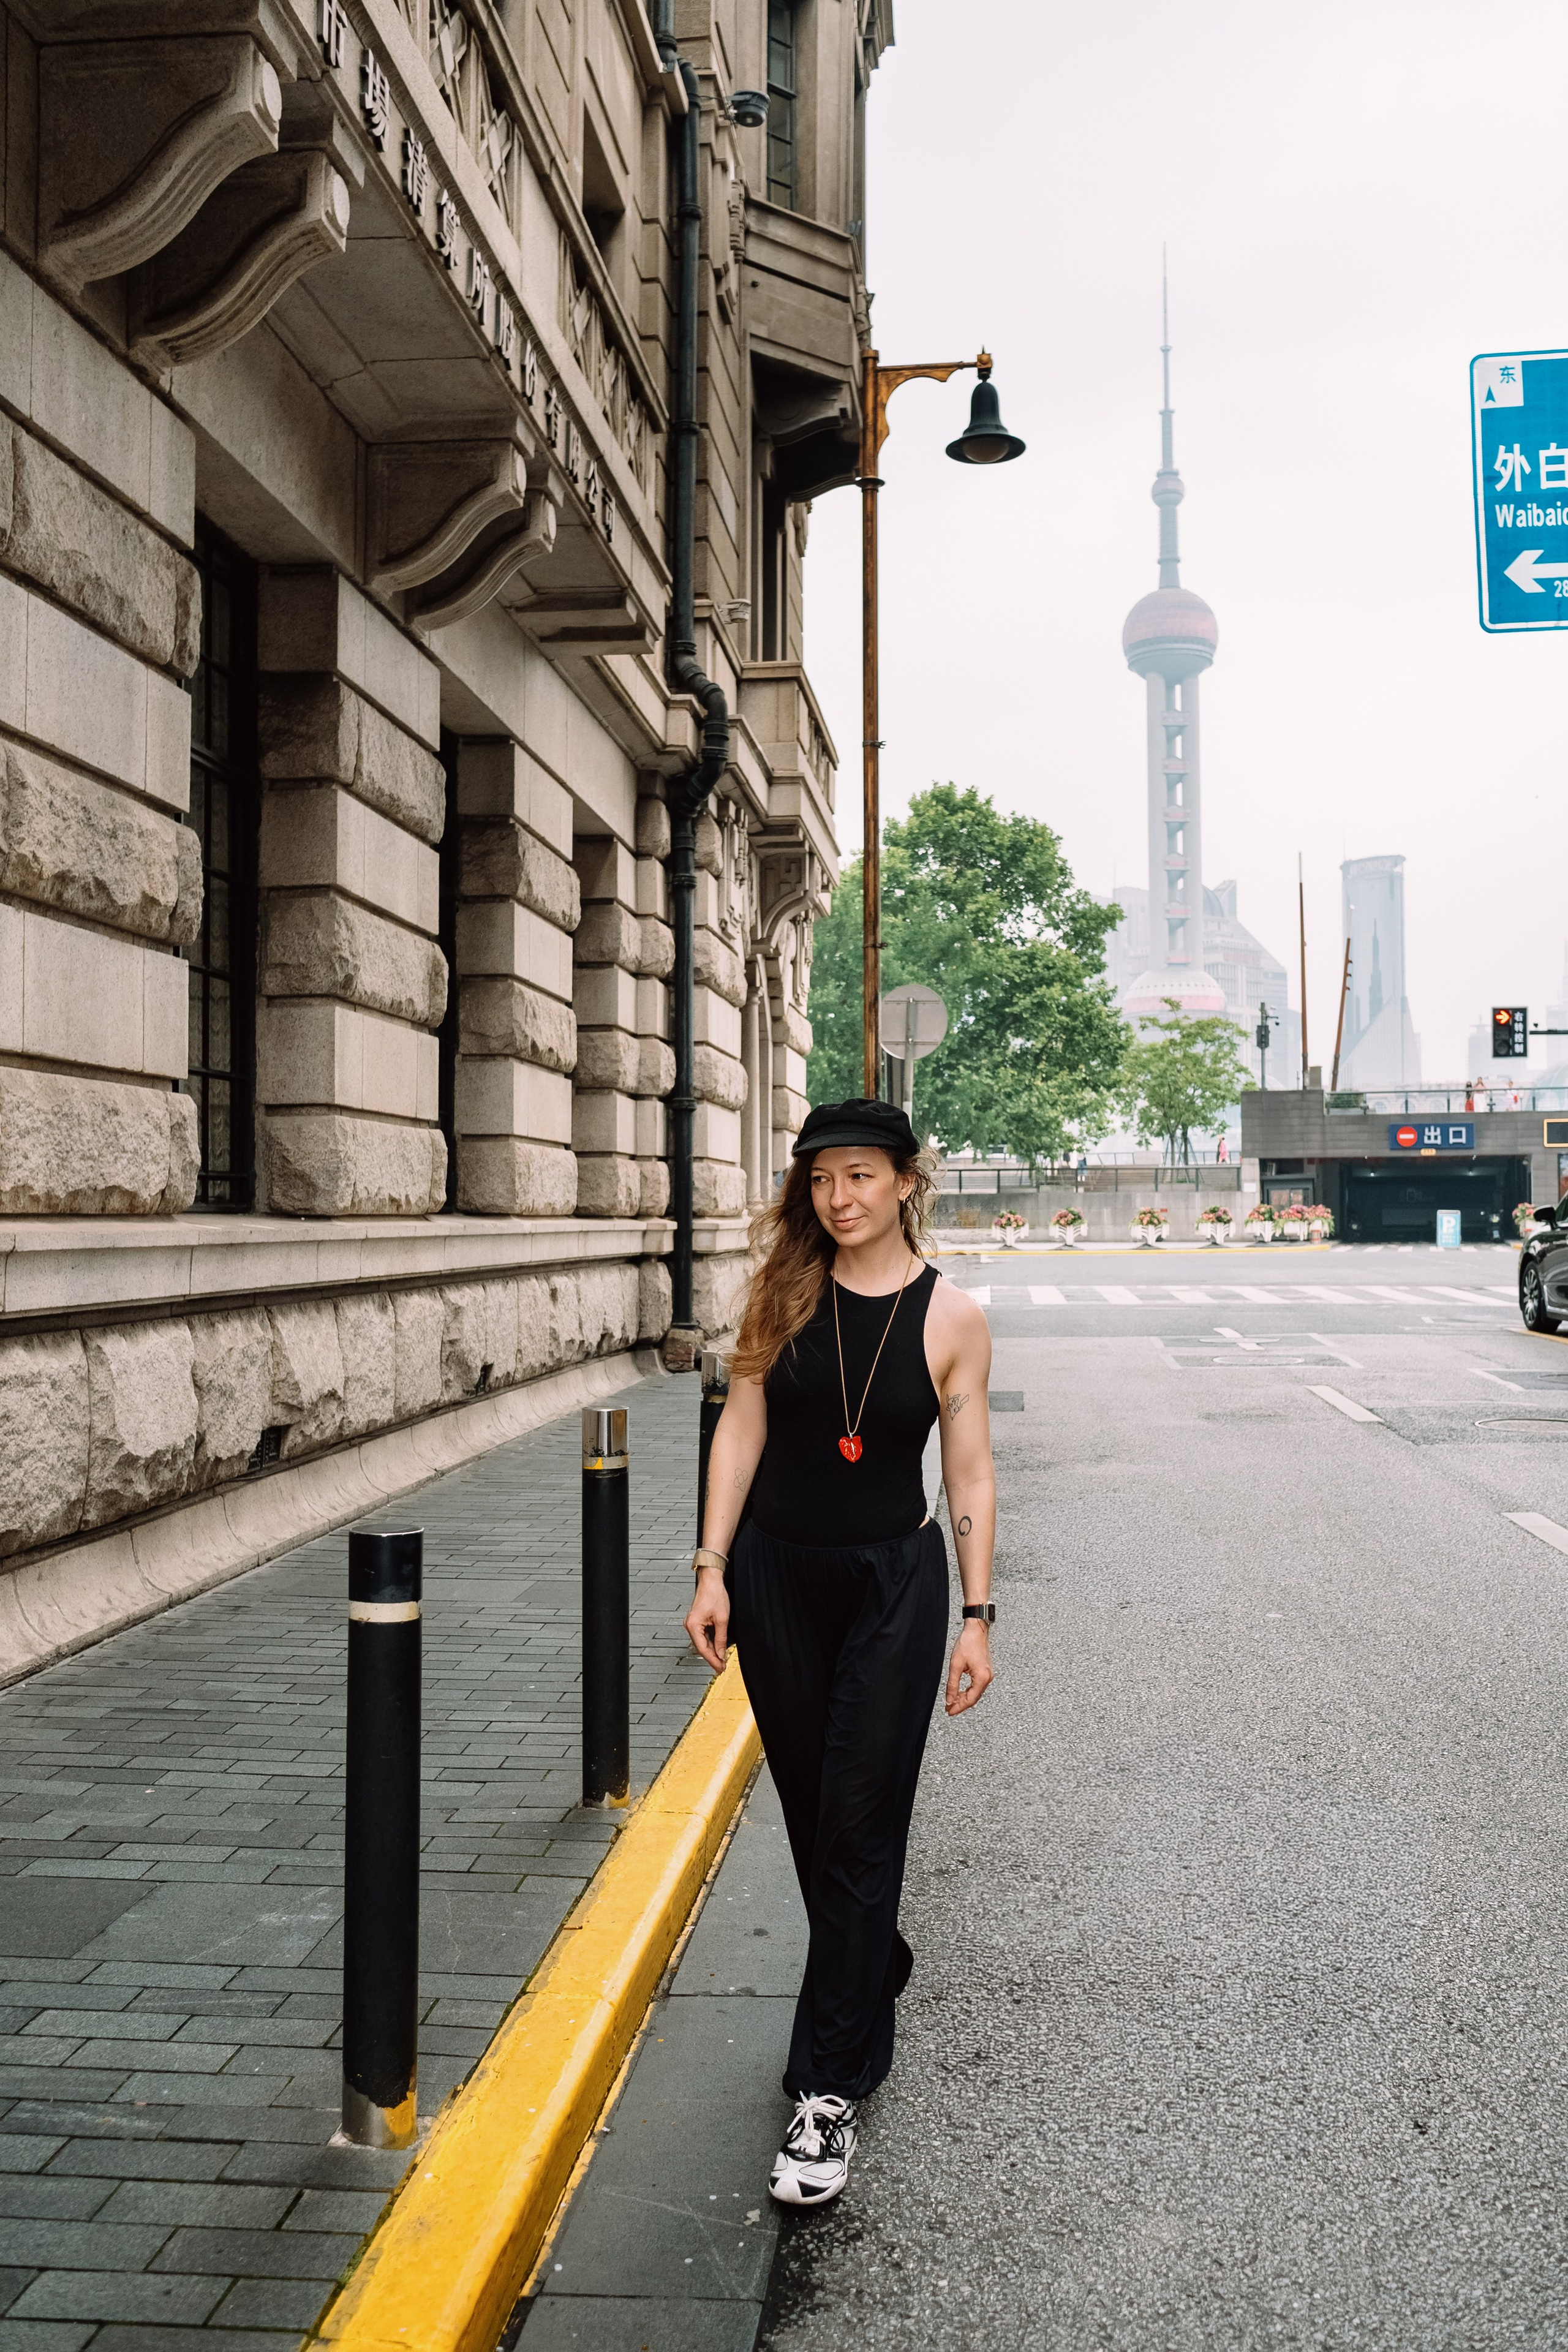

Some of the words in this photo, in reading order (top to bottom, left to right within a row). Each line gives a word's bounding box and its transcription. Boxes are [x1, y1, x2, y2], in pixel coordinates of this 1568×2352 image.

[1499, 365, 1516, 383] 东
[1493, 442, 1568, 492] 外白
[1423, 1125, 1466, 1145] 出口
